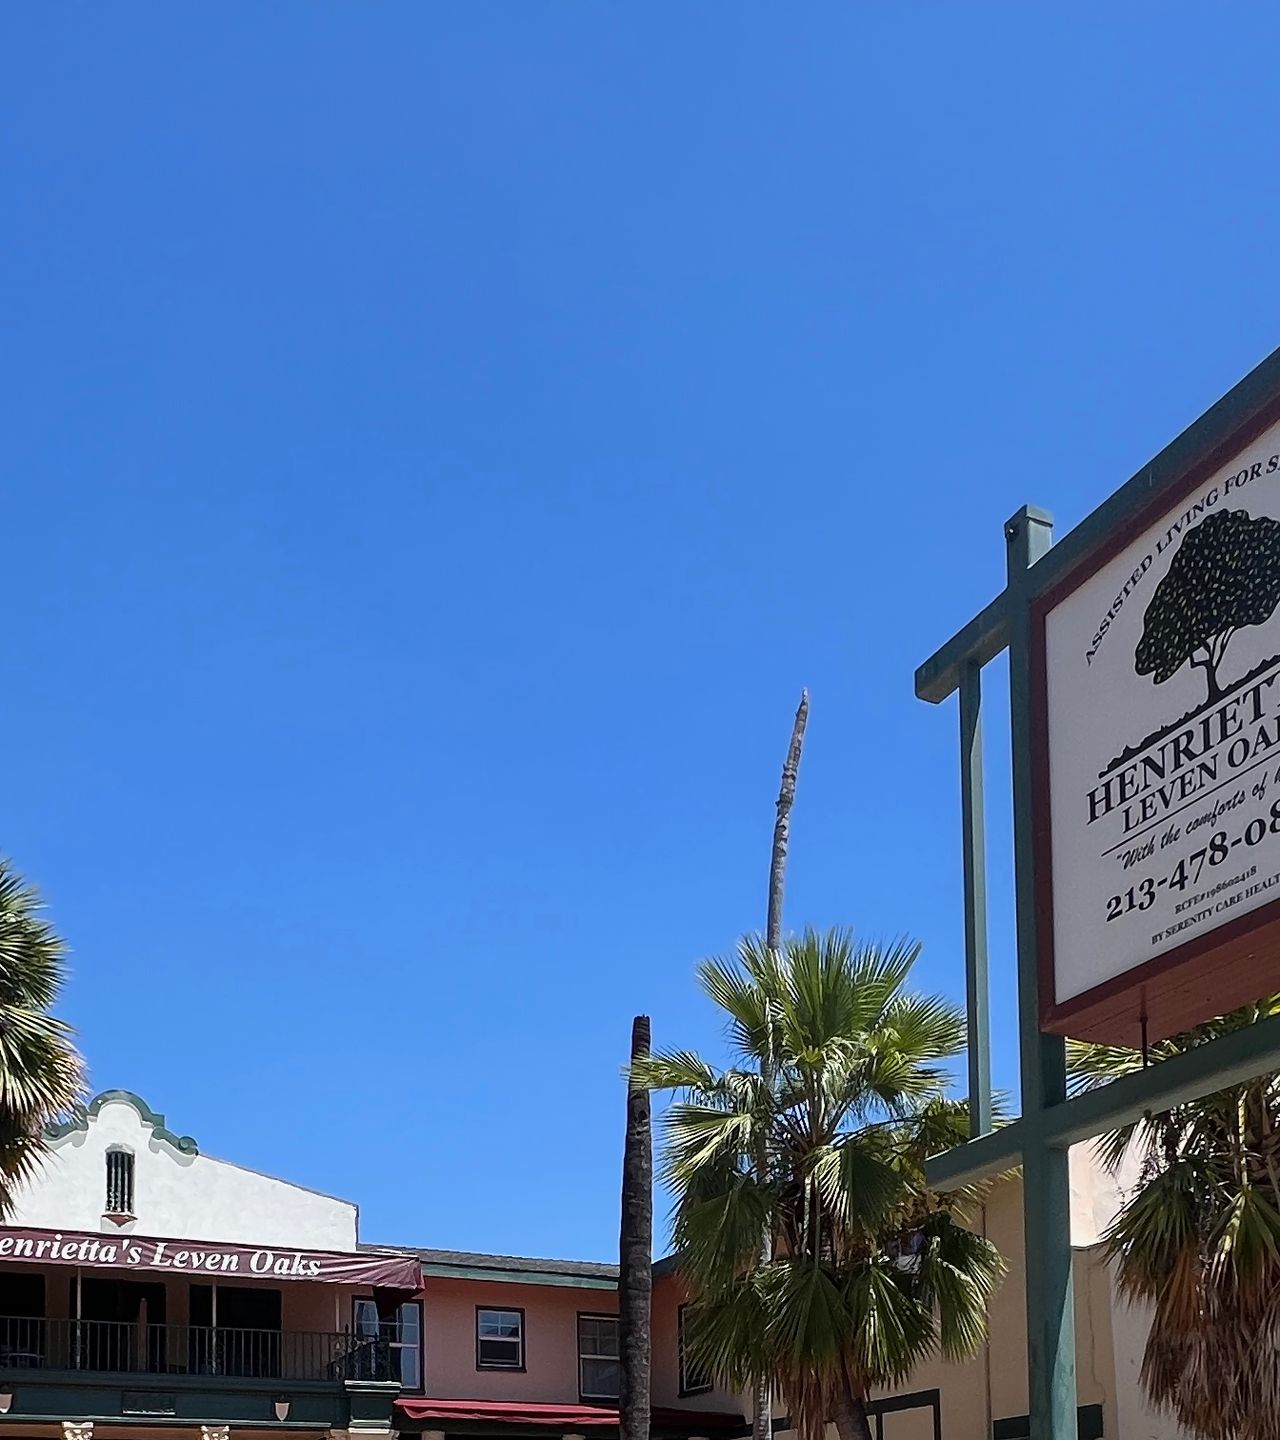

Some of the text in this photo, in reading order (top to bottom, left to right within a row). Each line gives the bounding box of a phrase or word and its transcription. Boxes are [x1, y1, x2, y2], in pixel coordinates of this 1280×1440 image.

[1085, 554, 1154, 667] ASSISTED
[1155, 488, 1219, 555] LIVING
[1223, 463, 1262, 498] FOR
[1122, 752, 1219, 834] LEVEN
[1161, 823, 1181, 850] the
[1186, 790, 1246, 835] comforts
[1252, 771, 1268, 801] of
[1151, 930, 1166, 945] BY
[1164, 906, 1215, 939] SERENITY
[1215, 892, 1243, 913] CARE
[150, 1242, 239, 1272] Leven
[250, 1250, 321, 1276] Oaks
